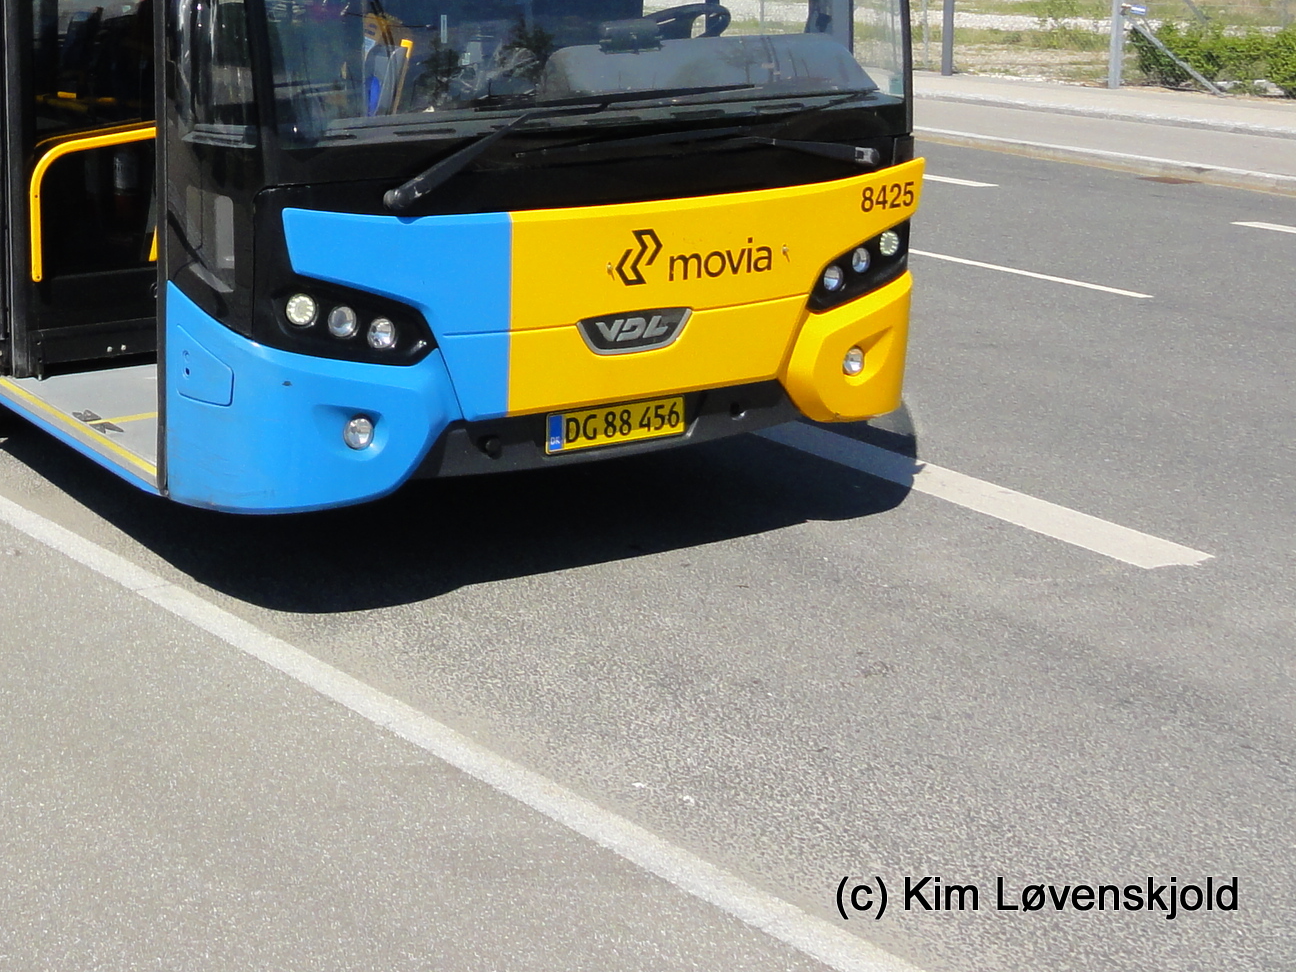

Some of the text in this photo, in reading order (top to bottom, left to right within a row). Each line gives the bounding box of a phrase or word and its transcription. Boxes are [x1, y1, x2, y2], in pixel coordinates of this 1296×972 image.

[861, 181, 915, 212] 8425
[668, 238, 772, 282] movia
[595, 315, 669, 342] VDL
[565, 401, 680, 443] DG 88 456
[550, 435, 561, 445] DK
